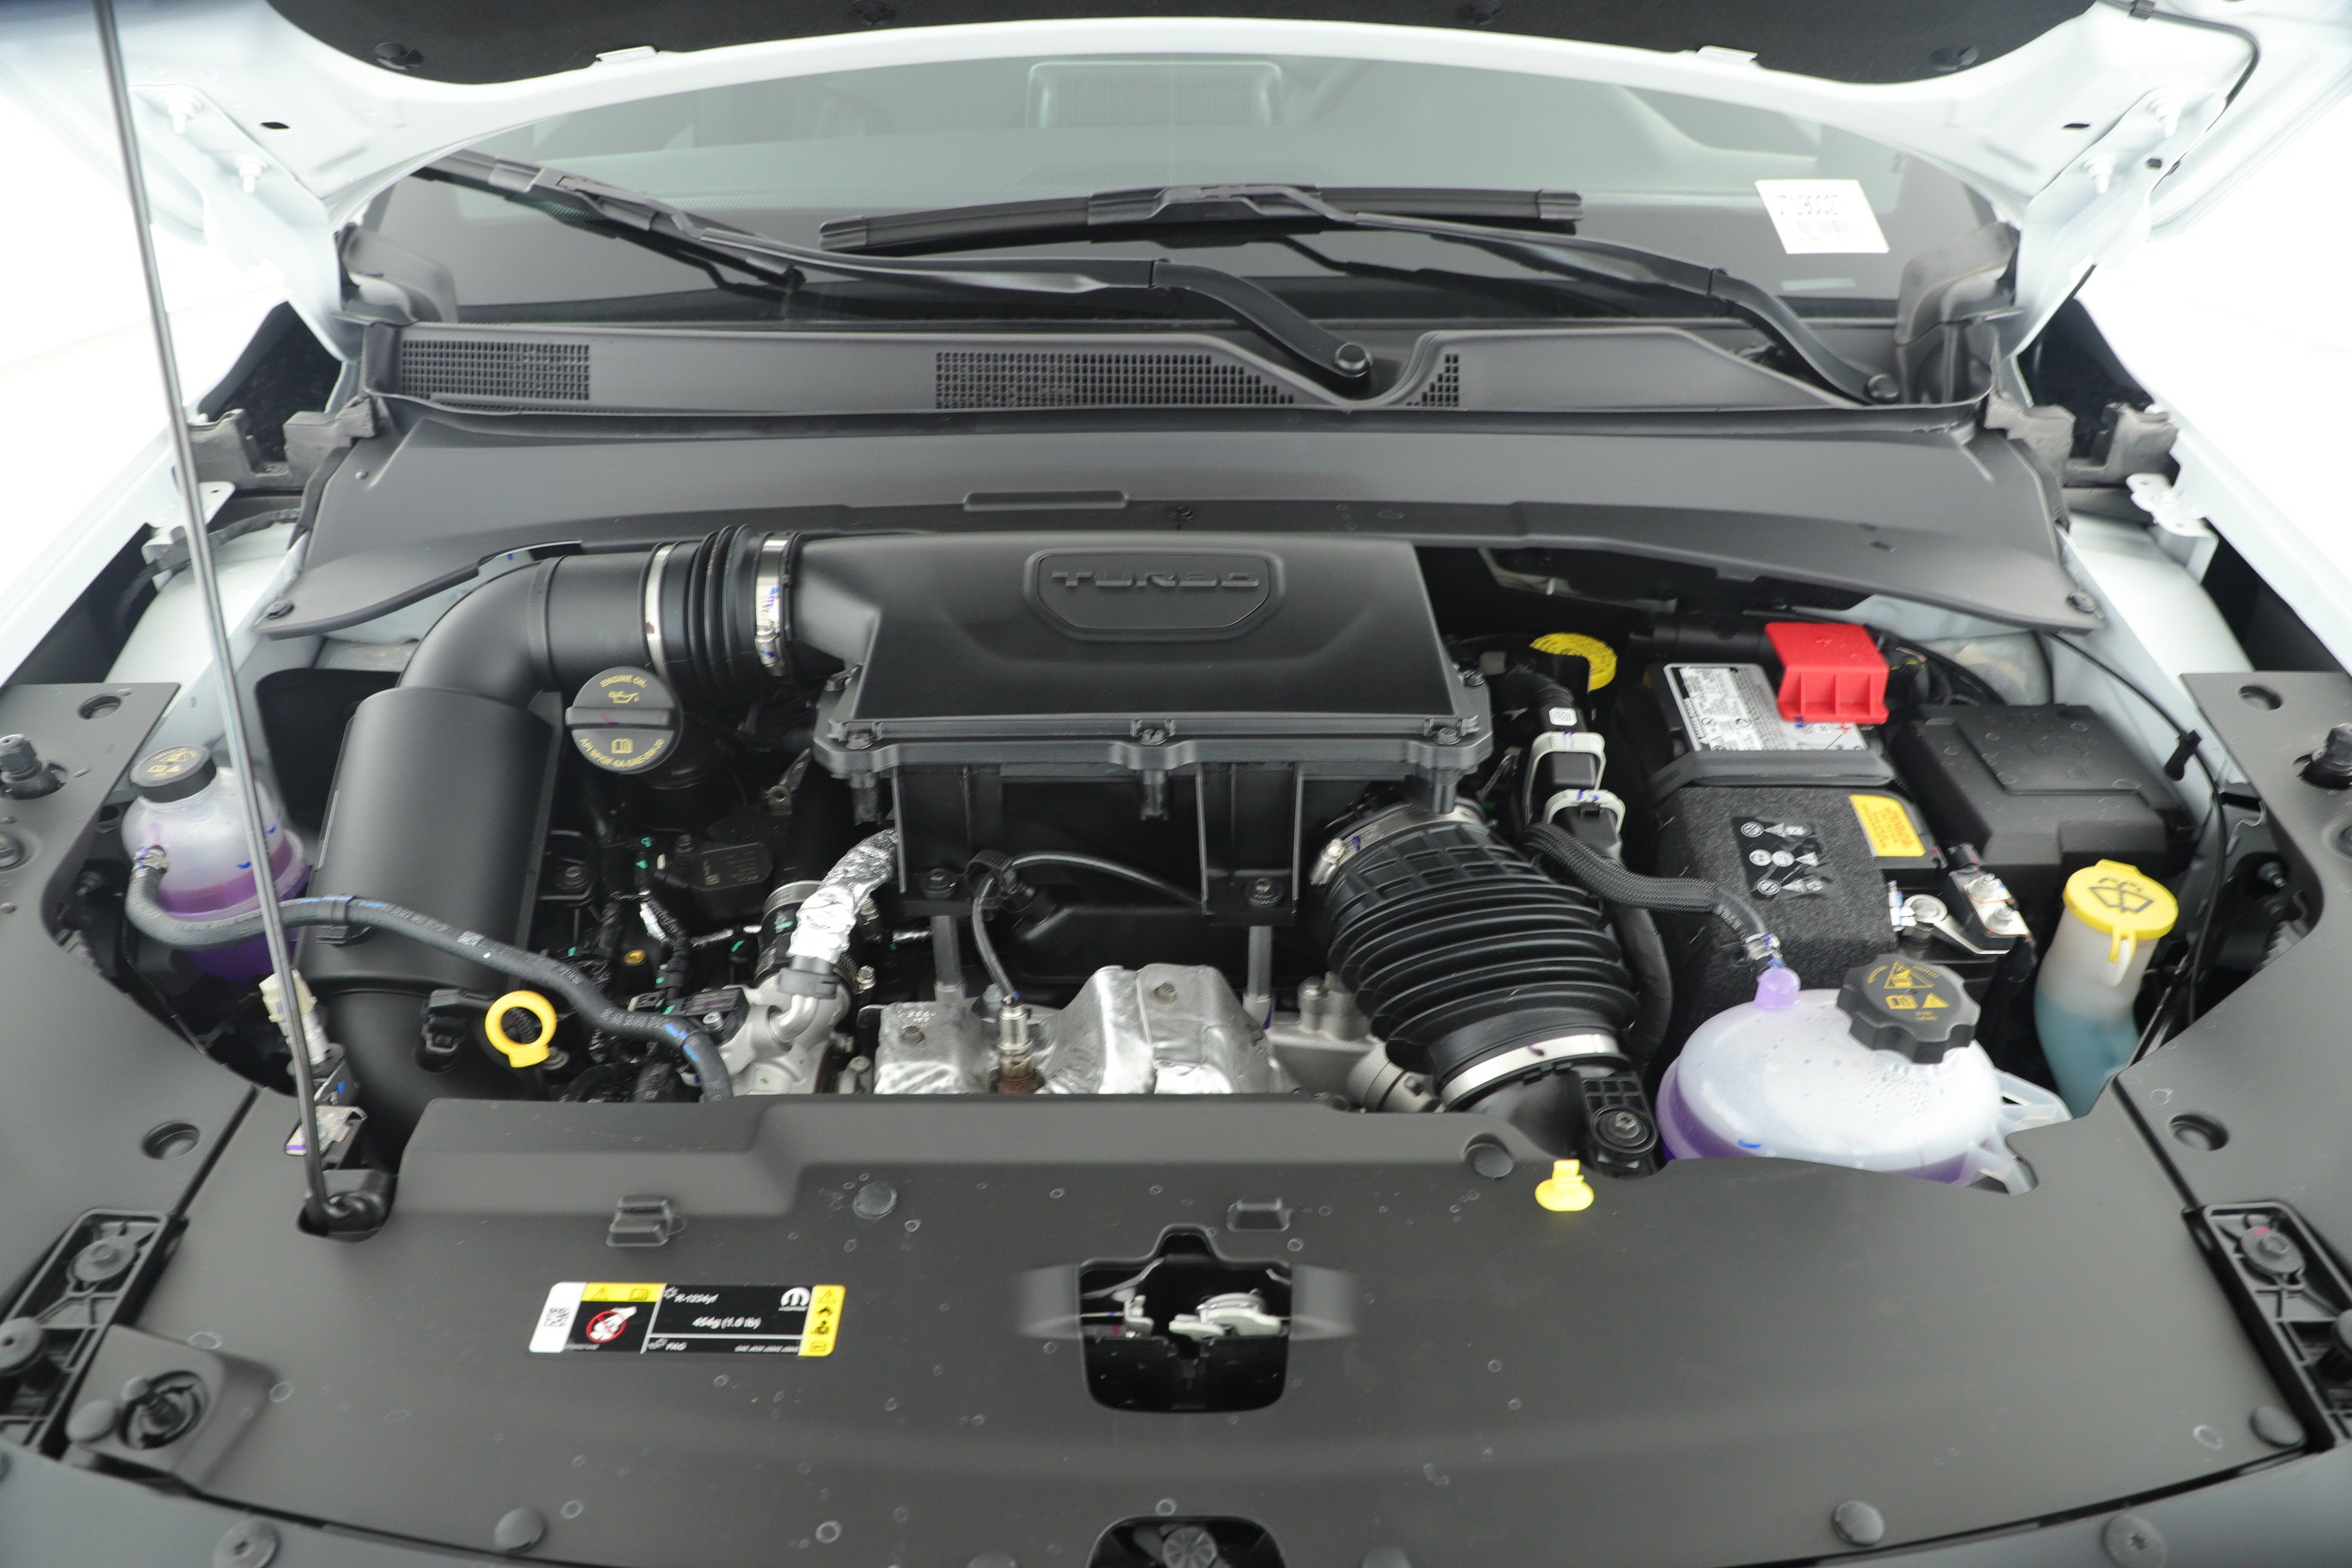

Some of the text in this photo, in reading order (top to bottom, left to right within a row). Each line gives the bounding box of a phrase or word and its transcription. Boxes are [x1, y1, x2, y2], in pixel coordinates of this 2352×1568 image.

[1052, 571, 1260, 588] TURBO
[599, 675, 648, 689] ENGINE OIL
[580, 738, 595, 752] API
[674, 1294, 720, 1305] R-1234yf
[691, 1316, 722, 1329] 454g
[743, 1317, 762, 1330] lb)
